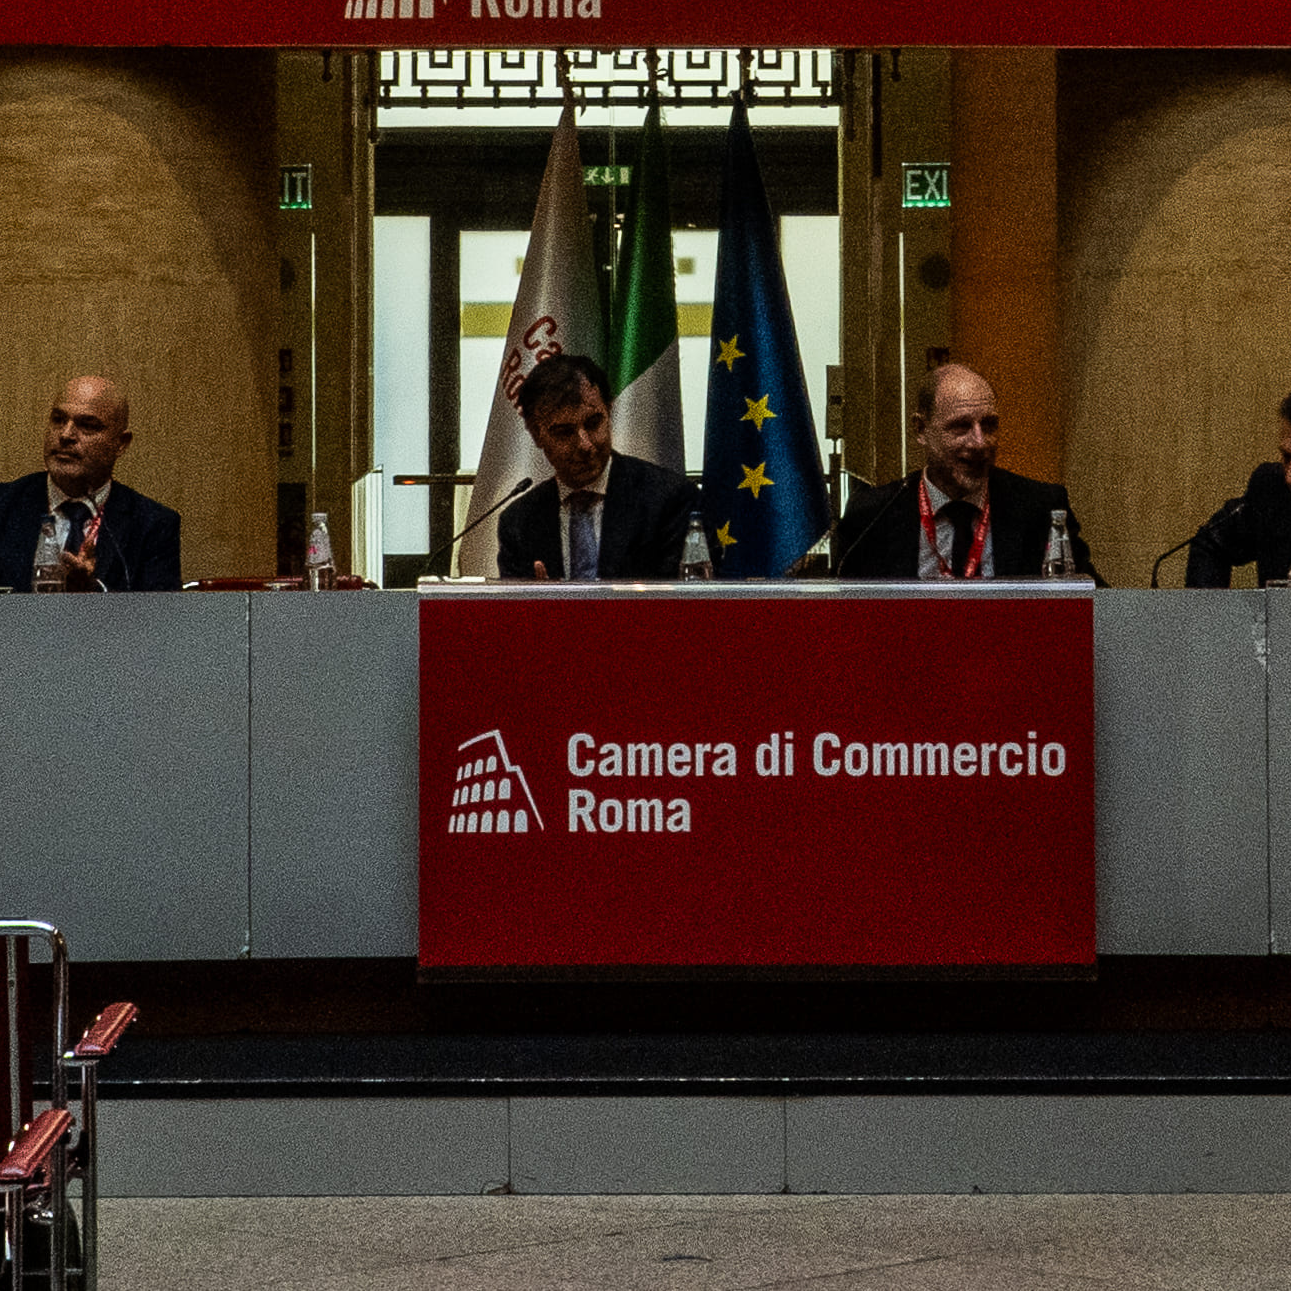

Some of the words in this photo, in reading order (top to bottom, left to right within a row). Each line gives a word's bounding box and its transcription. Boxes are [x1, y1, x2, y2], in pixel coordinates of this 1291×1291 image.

[278, 172, 307, 203] IT
[906, 170, 948, 200] EXI
[567, 733, 736, 777] Camera
[756, 731, 794, 776] di
[813, 731, 1066, 777] Commercio
[569, 789, 691, 833] Roma
